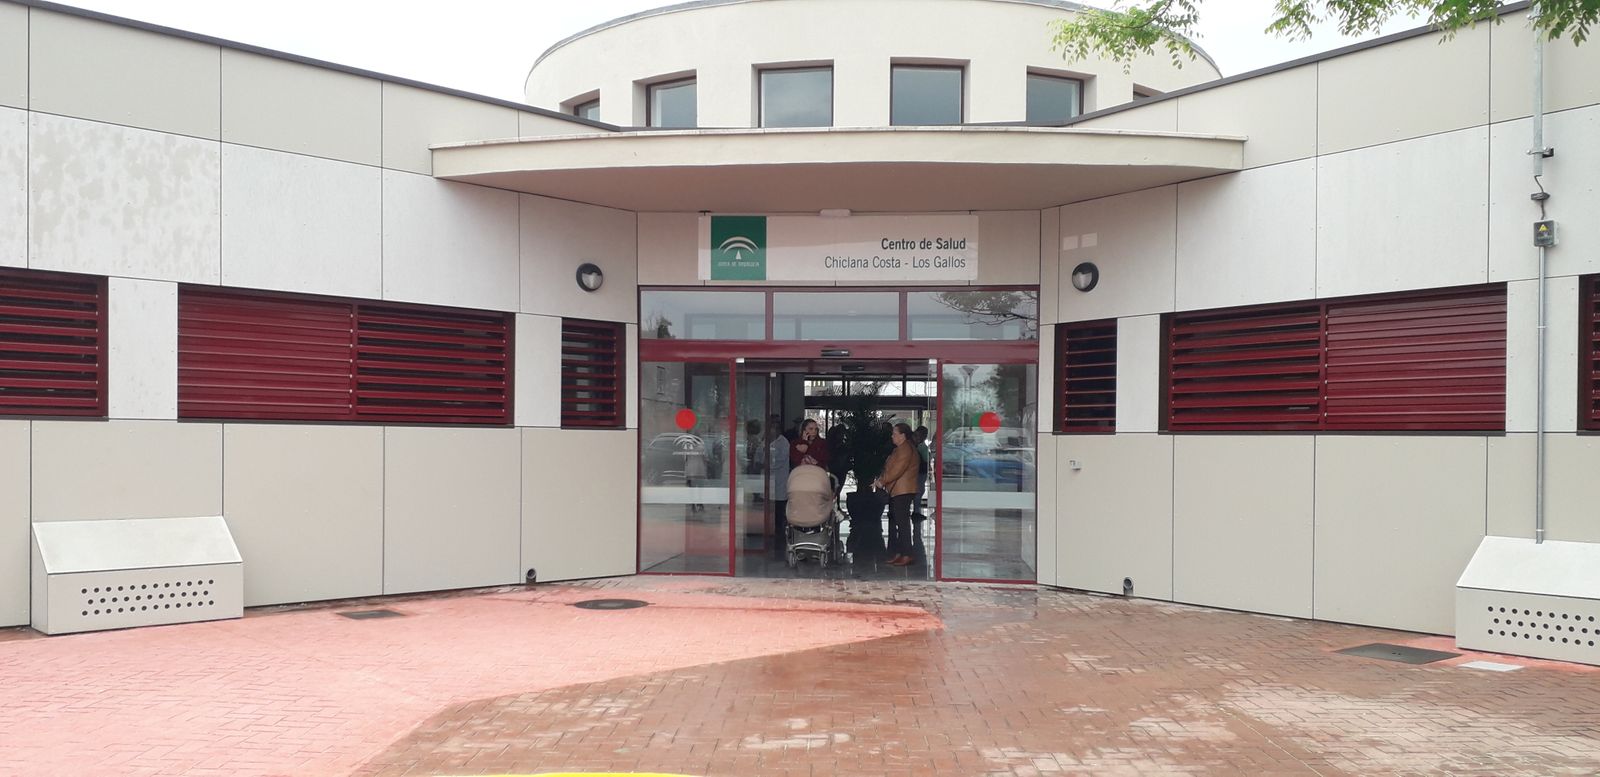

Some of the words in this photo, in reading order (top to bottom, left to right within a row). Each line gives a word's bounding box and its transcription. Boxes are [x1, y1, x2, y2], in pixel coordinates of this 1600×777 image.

[881, 238, 916, 250] Centro
[919, 238, 932, 250] de
[936, 238, 966, 250] Salud
[824, 256, 869, 268] Chiclana
[872, 256, 901, 268] Costa
[912, 256, 930, 268] Los
[933, 256, 966, 268] Gallos
